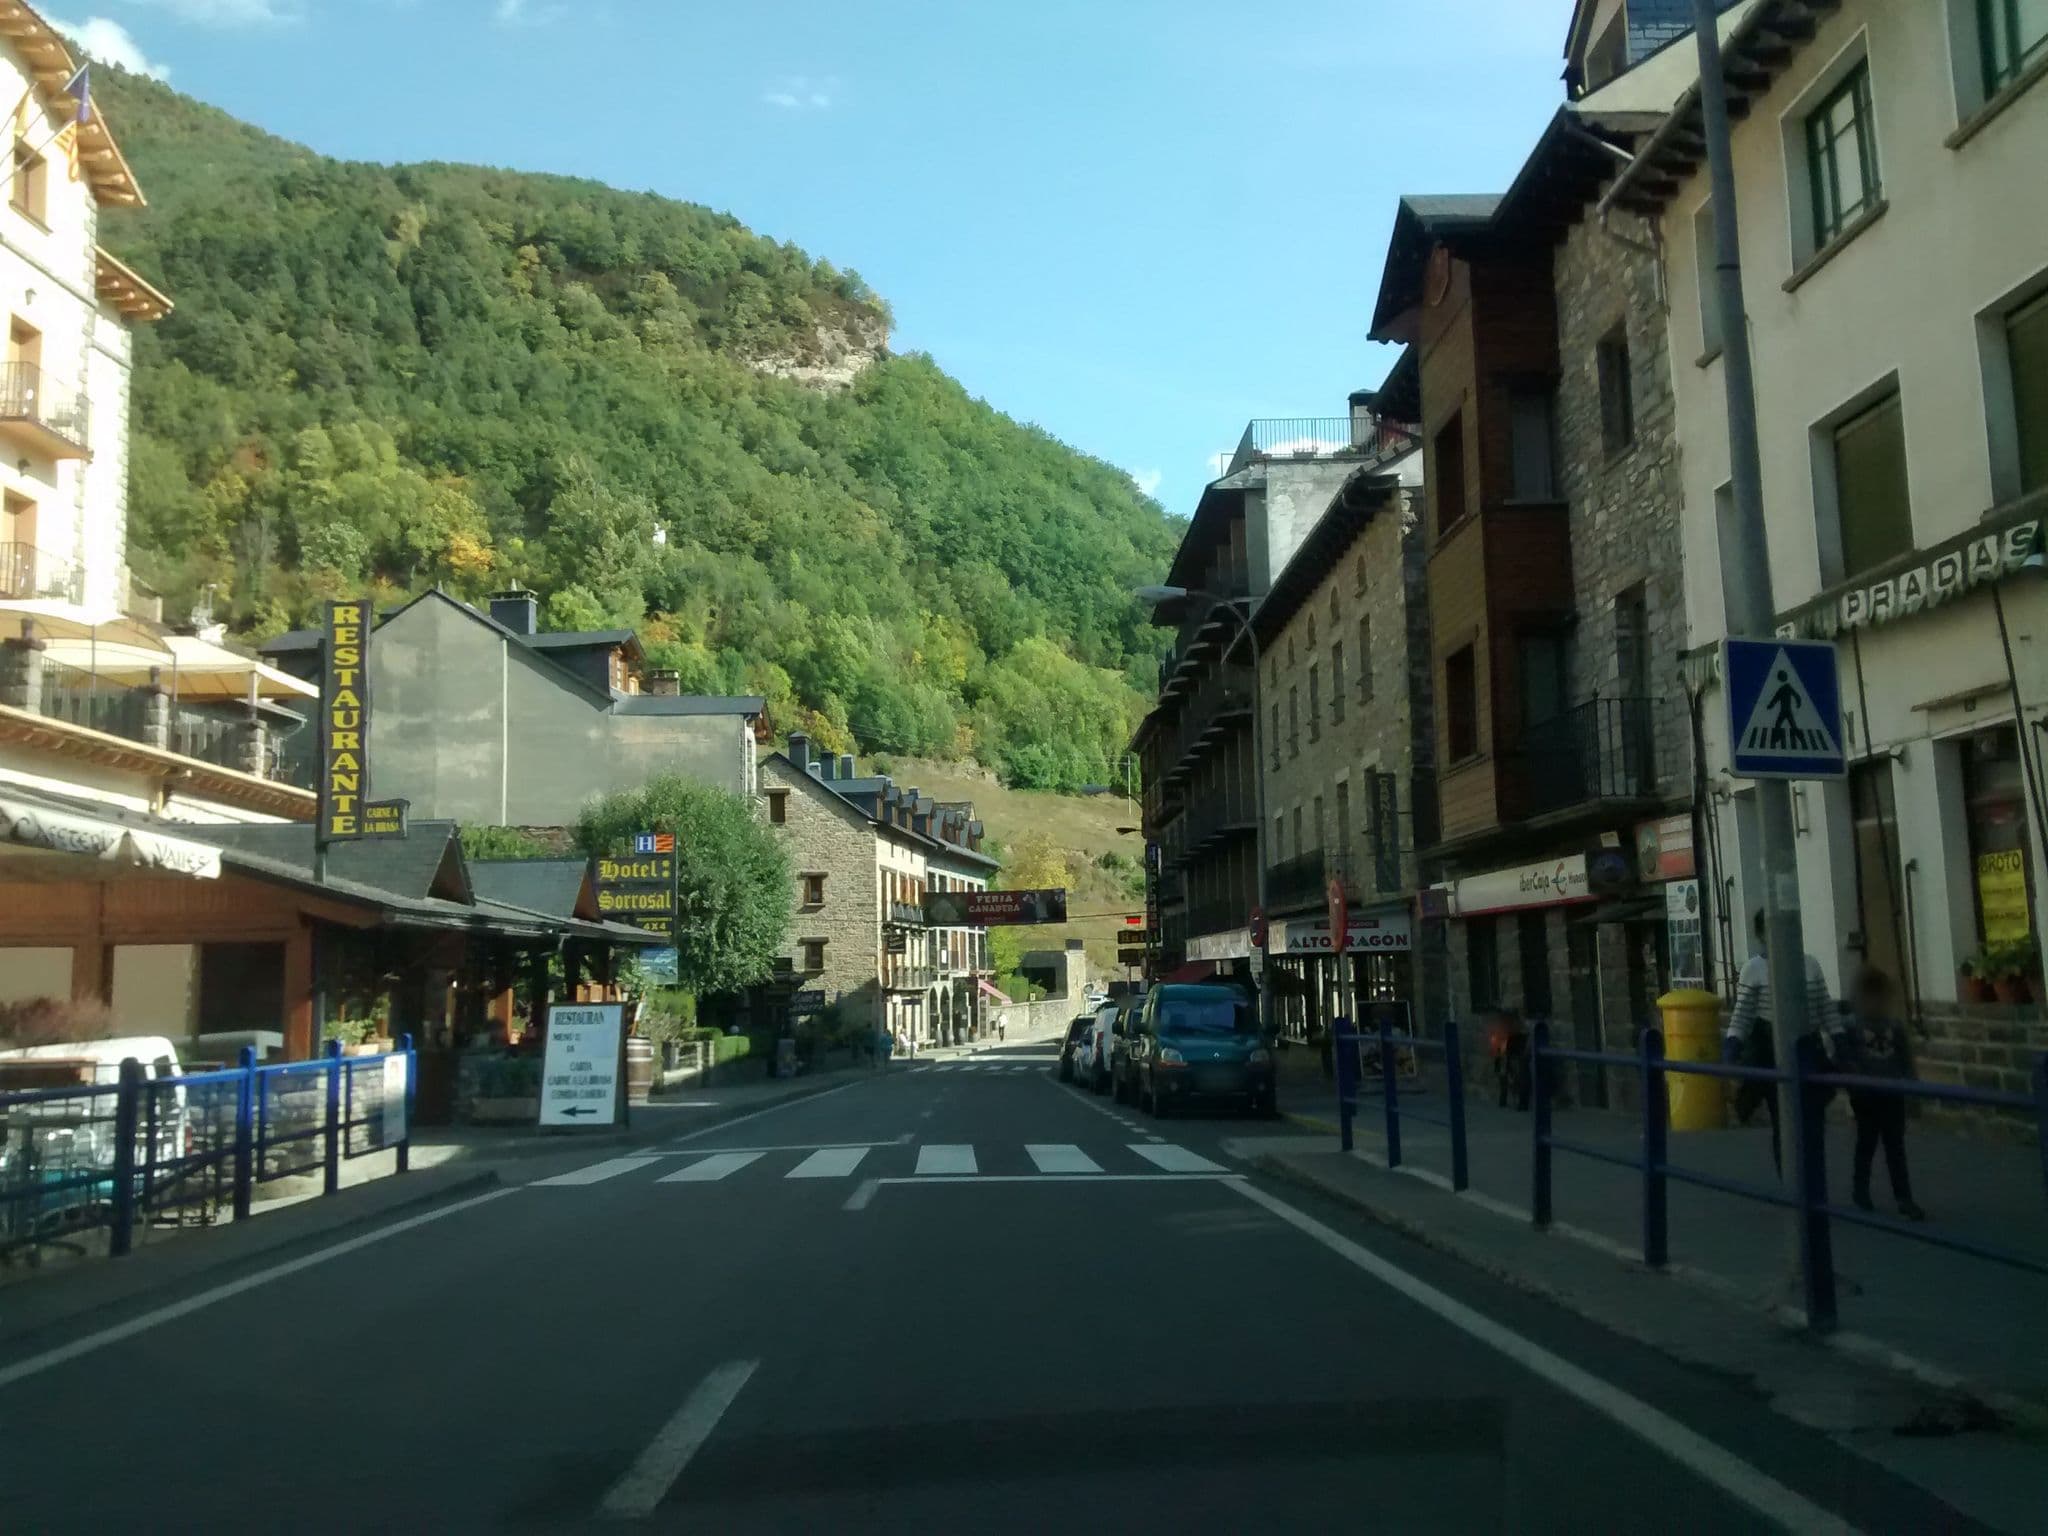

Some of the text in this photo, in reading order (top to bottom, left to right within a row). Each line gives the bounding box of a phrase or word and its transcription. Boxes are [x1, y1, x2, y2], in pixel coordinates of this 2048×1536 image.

[1840, 520, 2040, 626] PRADAS
[331, 605, 361, 835] RESTAURANTE
[598, 860, 657, 881] Hotel
[598, 889, 671, 911] Sorrosal
[975, 895, 1013, 904] FERIA
